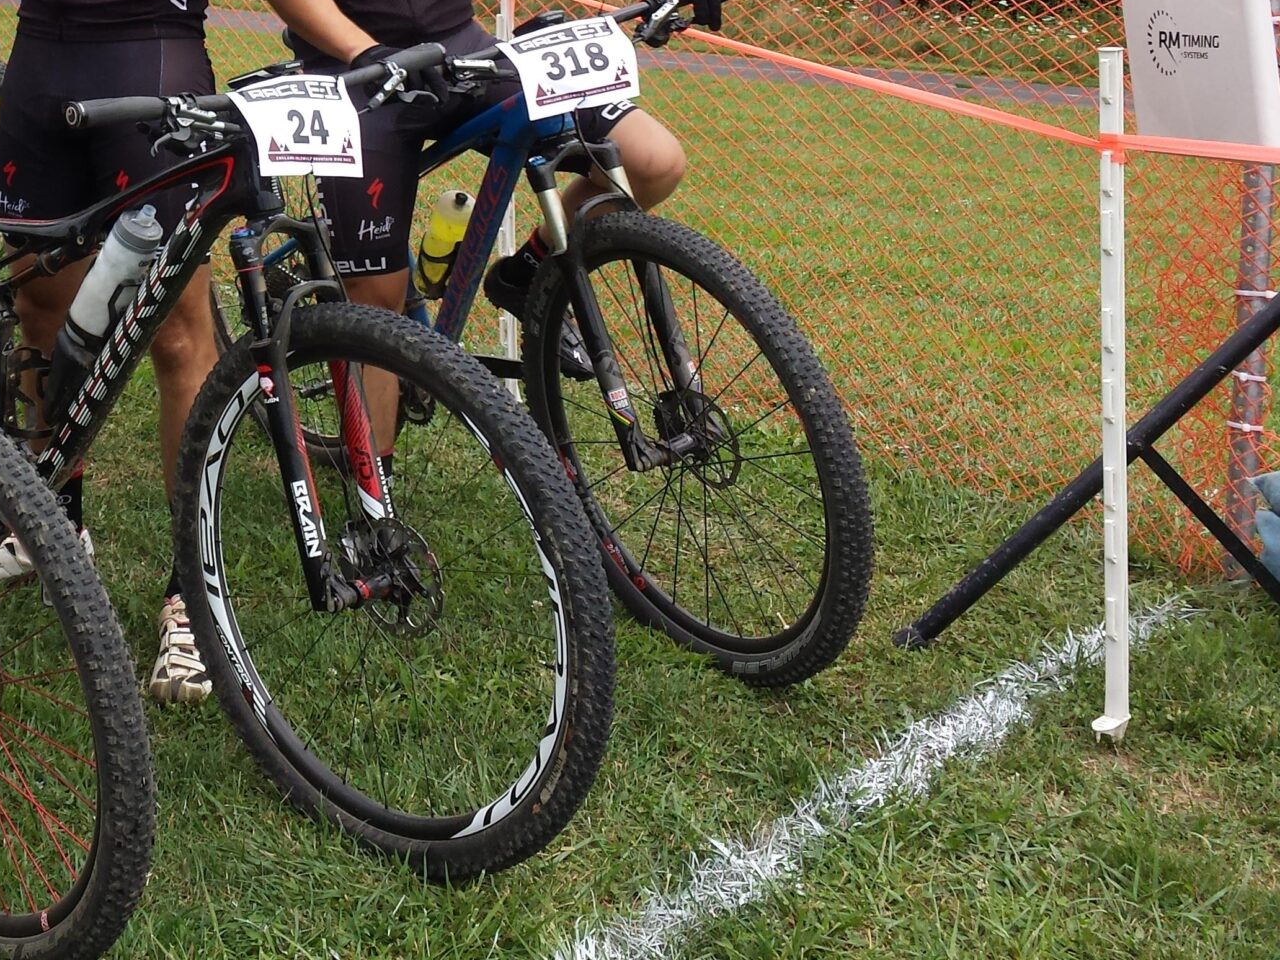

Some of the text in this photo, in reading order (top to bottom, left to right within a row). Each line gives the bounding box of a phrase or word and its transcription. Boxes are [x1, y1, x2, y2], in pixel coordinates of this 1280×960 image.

[1158, 30, 1220, 50] RM TIMING
[541, 42, 610, 81] 318
[1183, 51, 1209, 60] SYSTEMS
[247, 83, 306, 100] RACE
[287, 109, 330, 145] 24
[337, 256, 387, 273] ELLI
[290, 479, 323, 559] BRAIN
[215, 624, 253, 692] CONTROL
